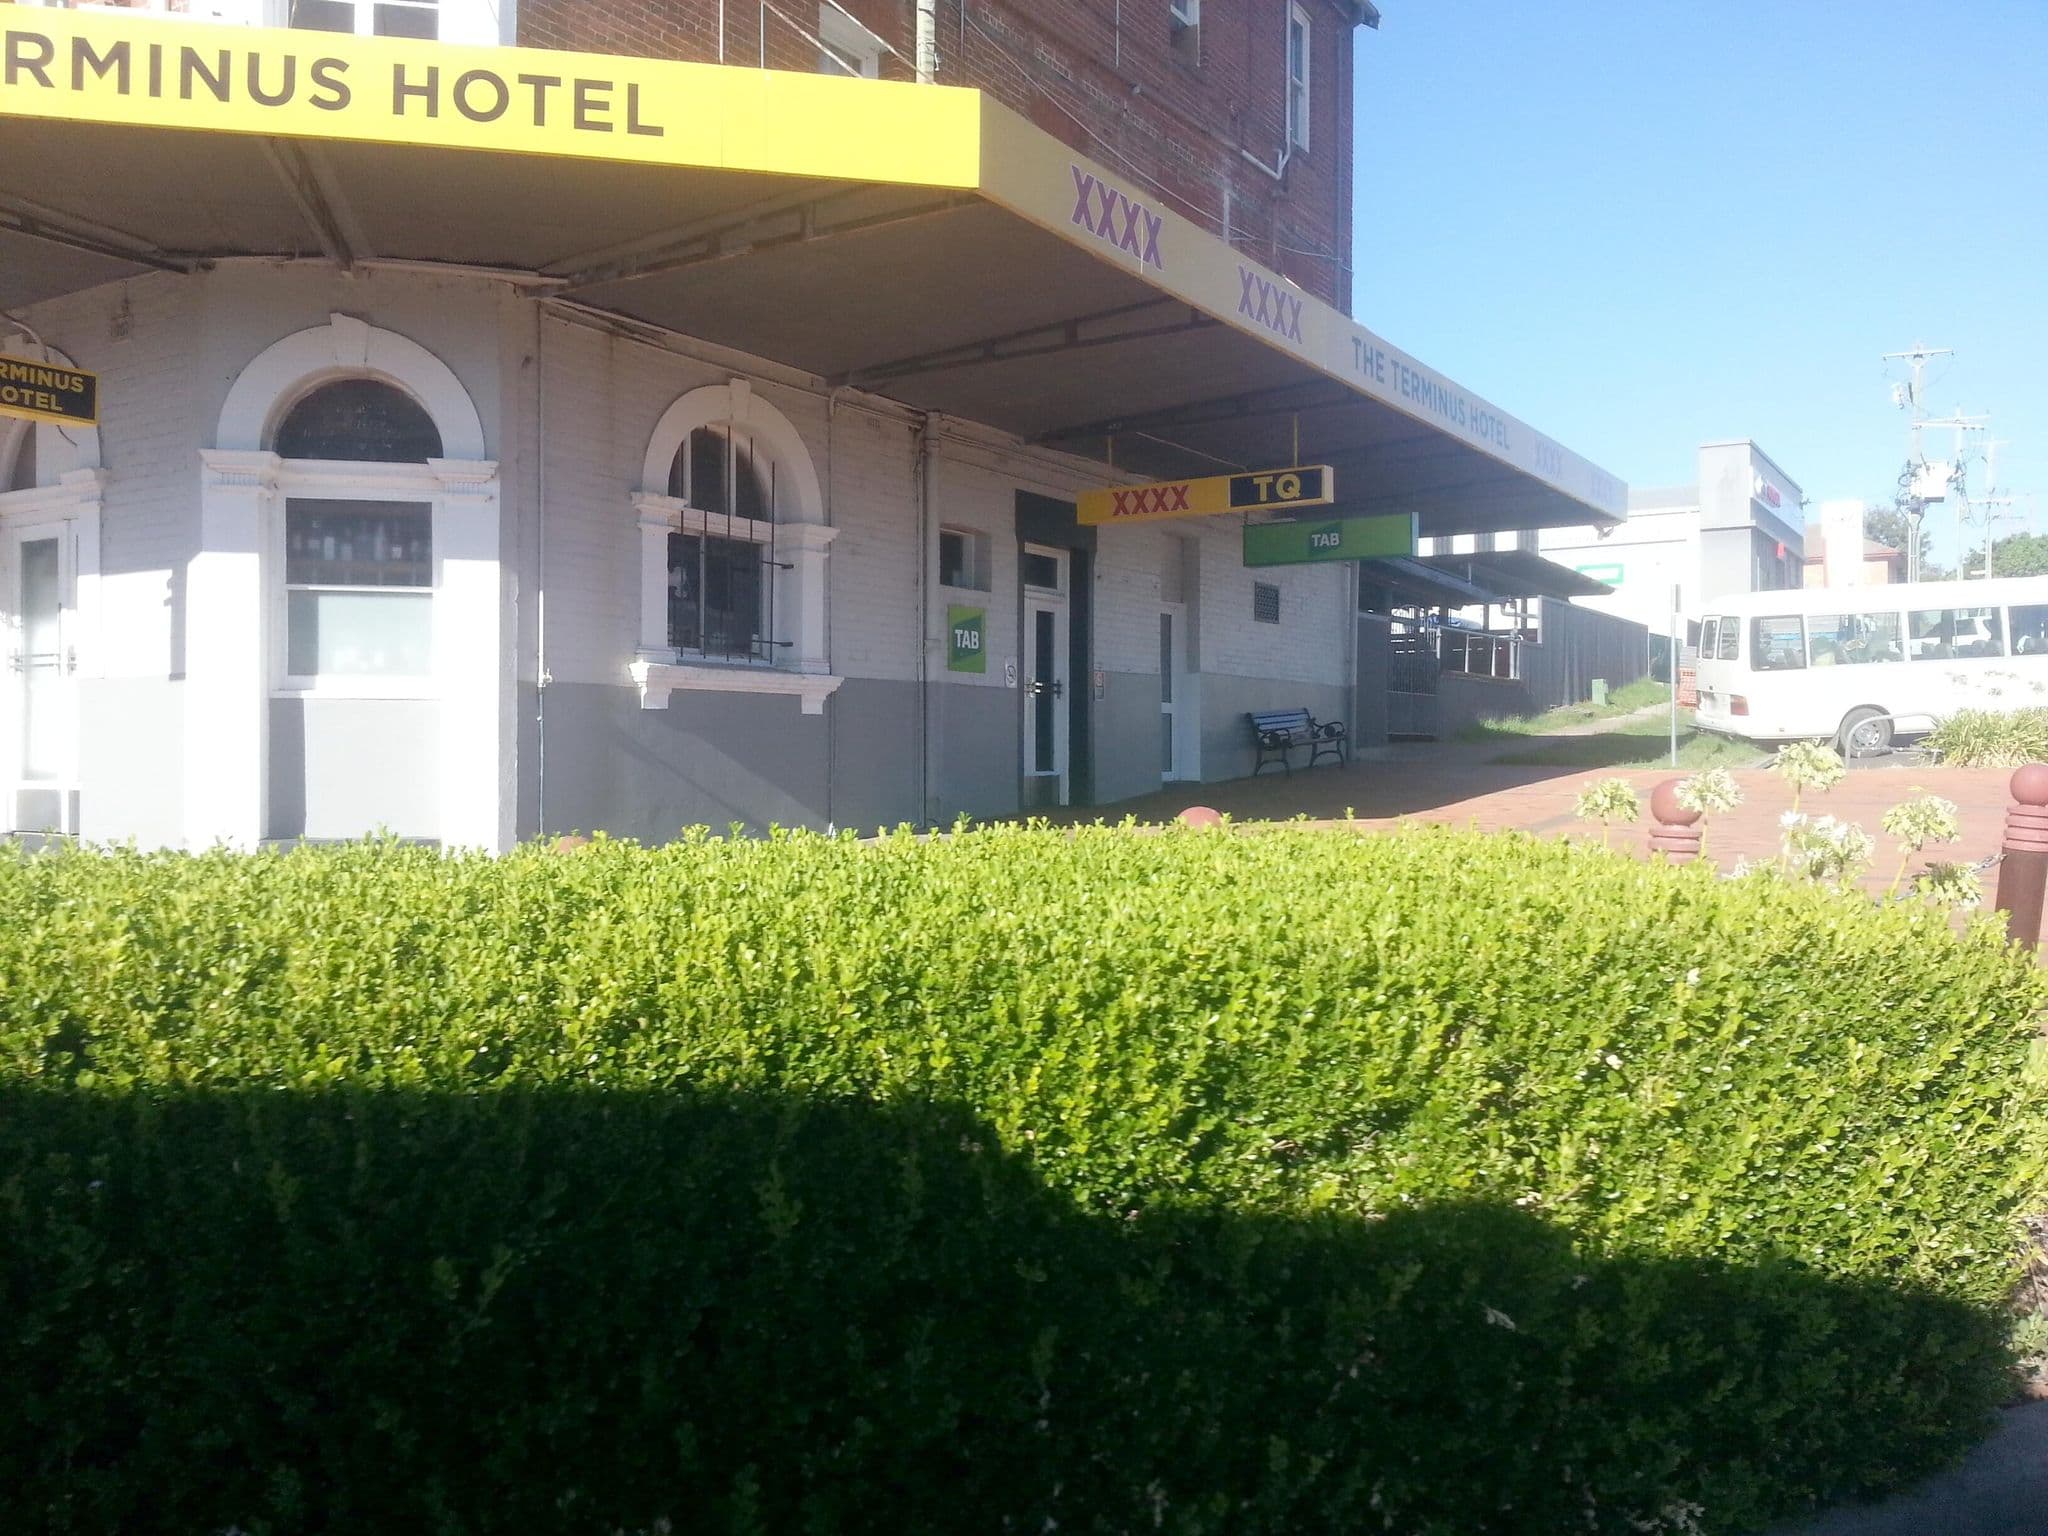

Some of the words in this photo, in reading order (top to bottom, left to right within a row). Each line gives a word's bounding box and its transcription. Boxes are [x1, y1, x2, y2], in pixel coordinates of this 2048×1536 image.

[4, 30, 351, 112] RMINUS
[392, 63, 664, 138] HOTEL
[1071, 164, 1163, 271] XXXX
[1237, 264, 1303, 345] XXXX
[1, 385, 63, 412] OTEL
[1351, 335, 1385, 384] THE
[1391, 358, 1465, 428] TERMINUS
[1470, 402, 1511, 450] HOTEL
[1112, 484, 1190, 517] XXXX
[1253, 473, 1301, 502] TQ
[1311, 532, 1340, 548] TAB
[954, 628, 979, 650] TAB
